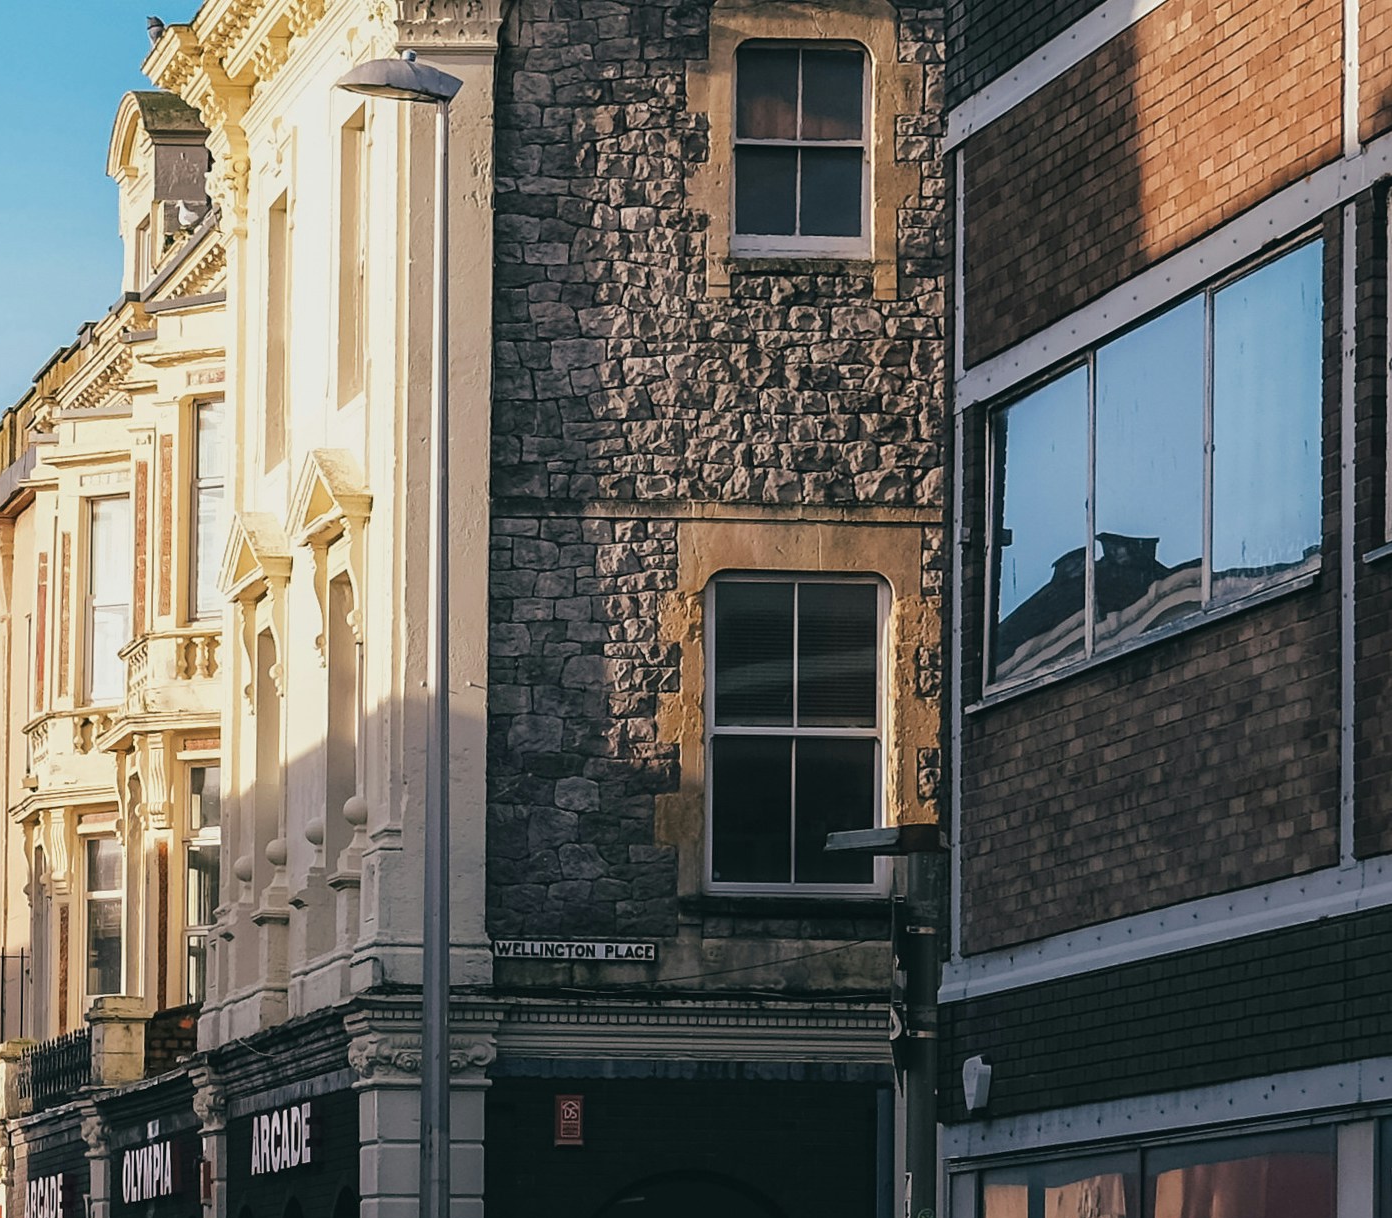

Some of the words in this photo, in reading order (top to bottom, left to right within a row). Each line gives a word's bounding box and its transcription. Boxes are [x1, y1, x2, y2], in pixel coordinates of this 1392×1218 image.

[495, 941, 596, 957] WELLINGTON
[604, 943, 654, 959] PLACE
[251, 1101, 312, 1176] ARCADE
[122, 1140, 173, 1205] OLYMPIA
